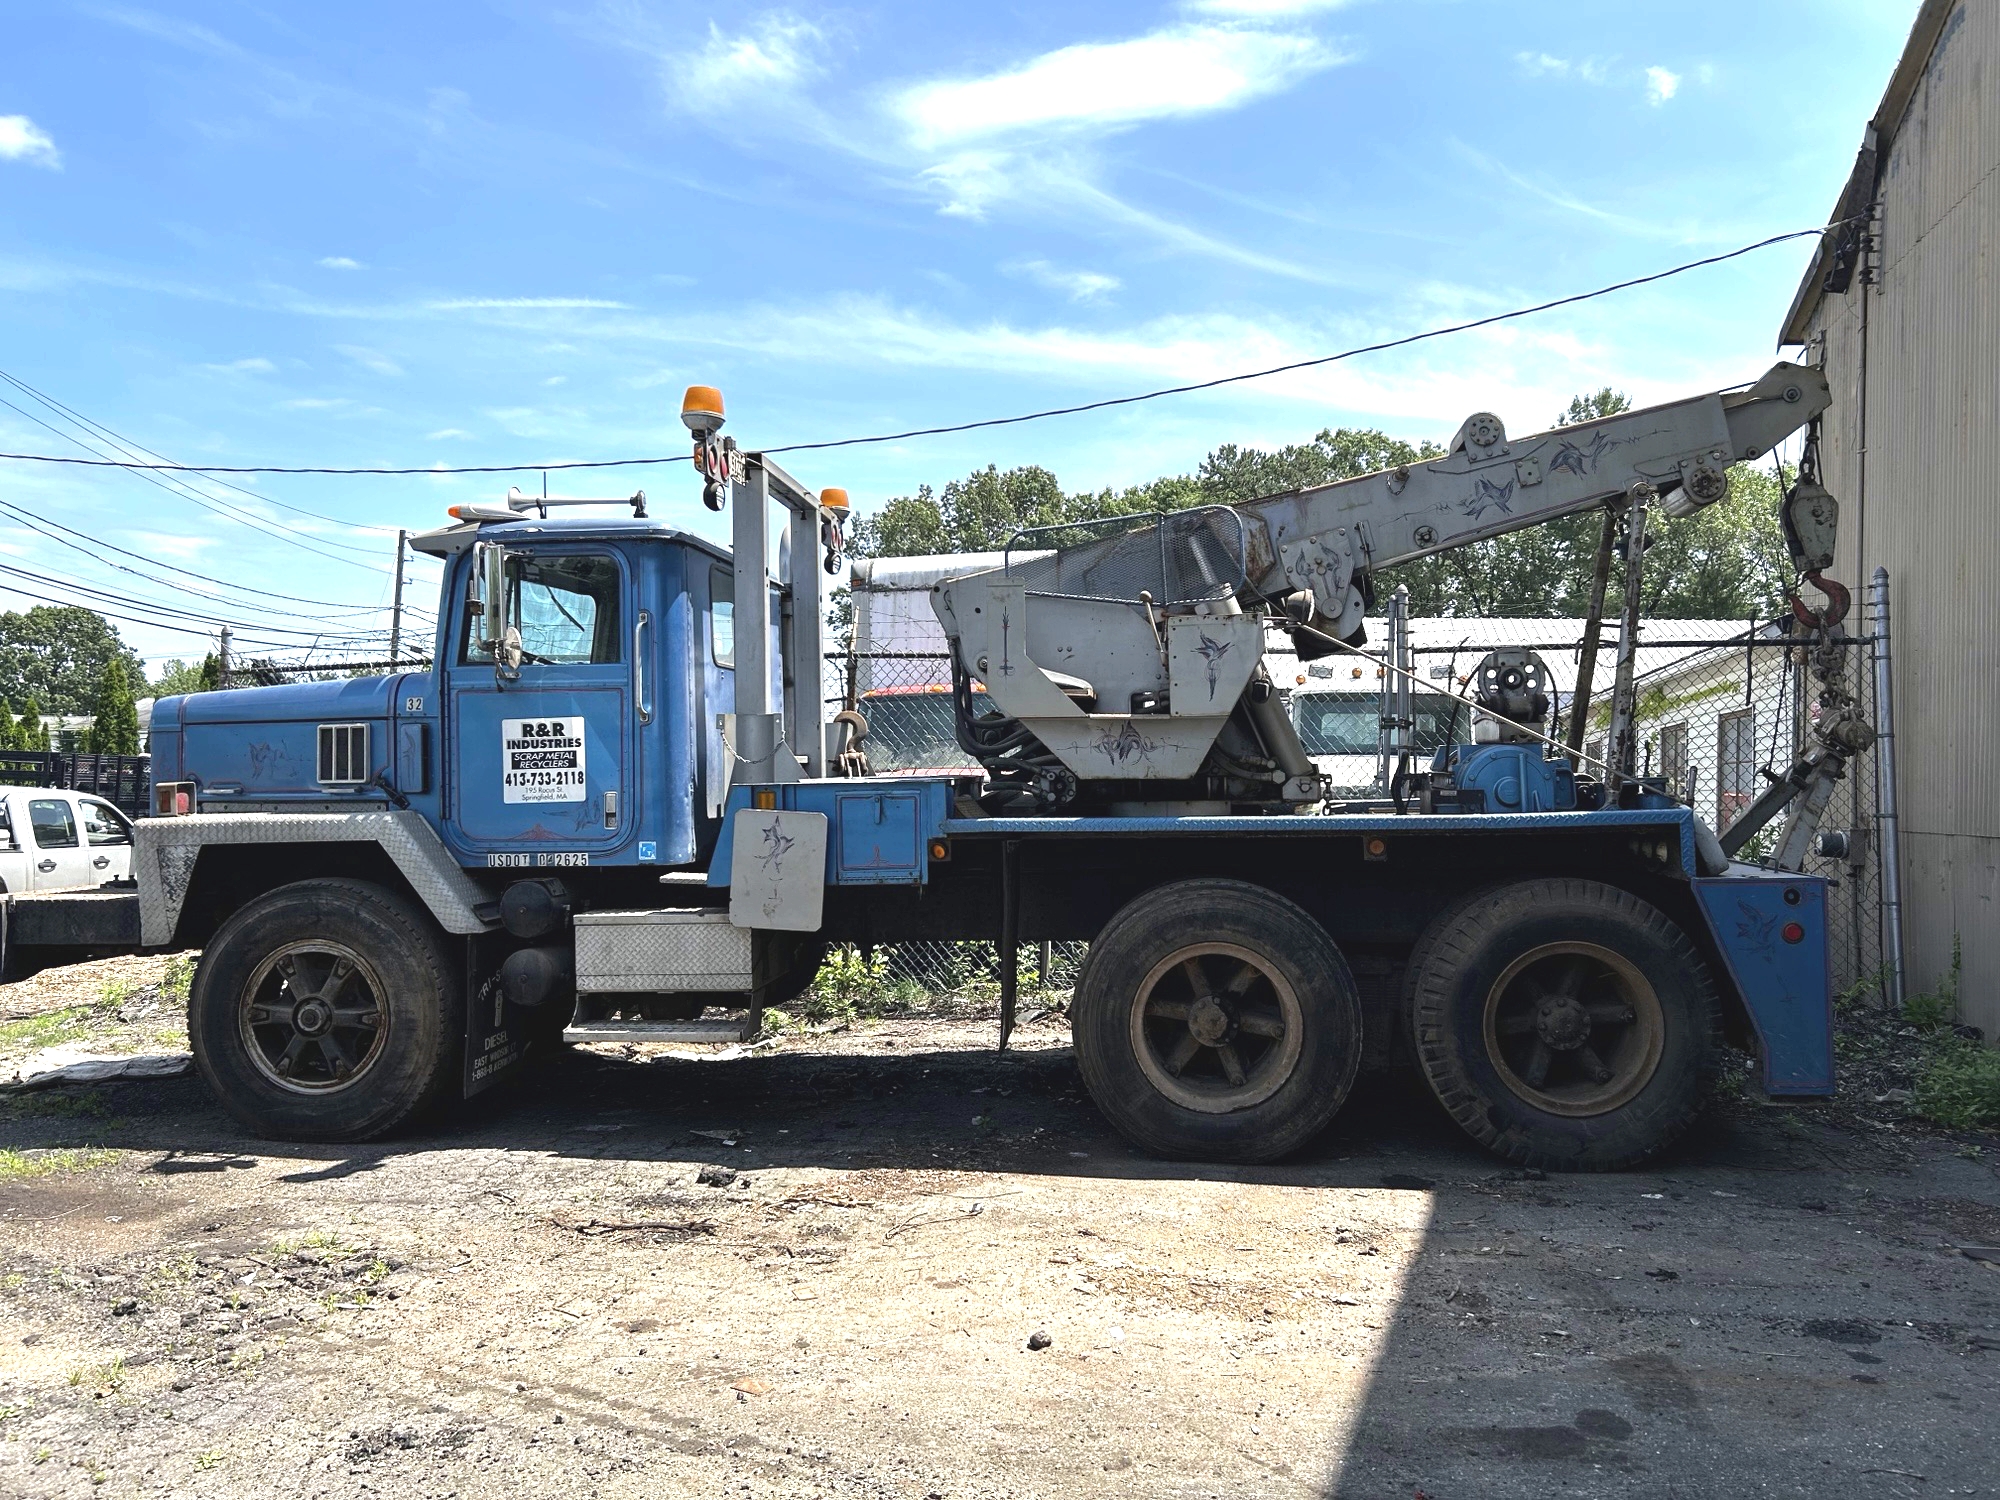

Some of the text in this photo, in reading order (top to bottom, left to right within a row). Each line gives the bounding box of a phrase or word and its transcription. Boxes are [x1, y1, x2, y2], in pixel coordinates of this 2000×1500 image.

[407, 698, 422, 710] 32
[522, 722, 566, 738] R&R
[506, 738, 582, 750] INDUSTRIES
[514, 751, 575, 761] SCRAP METAL
[519, 760, 569, 769] RECYCLERS
[505, 771, 584, 787] 413-733-2118
[525, 786, 537, 794] 195
[489, 853, 588, 867] USDOT 02625
[484, 1030, 509, 1051] DIESEL
[474, 1055, 489, 1069] EAST
